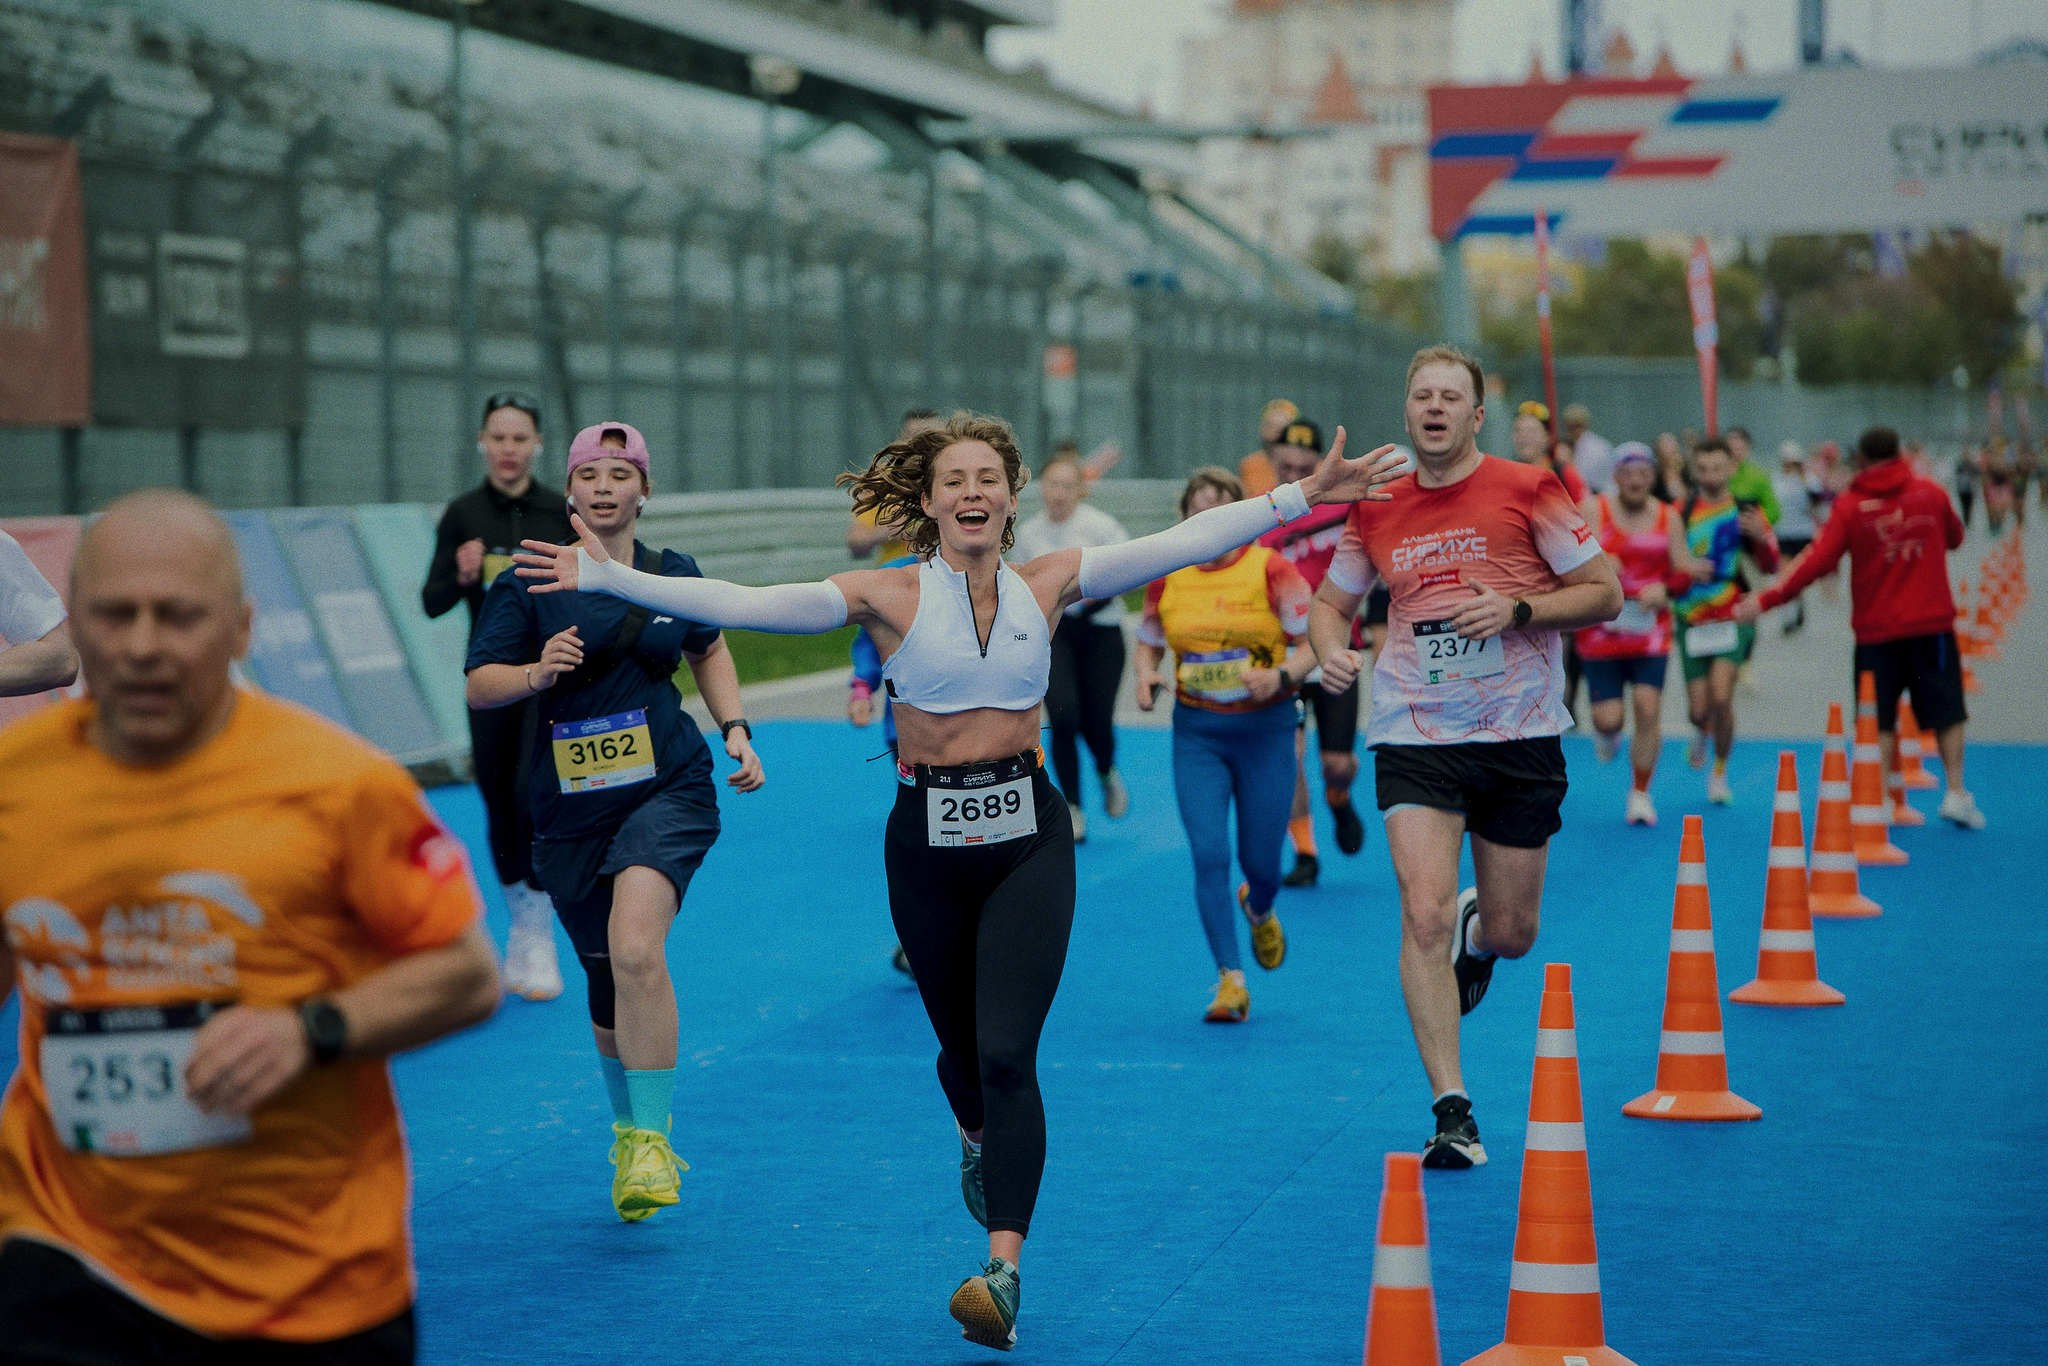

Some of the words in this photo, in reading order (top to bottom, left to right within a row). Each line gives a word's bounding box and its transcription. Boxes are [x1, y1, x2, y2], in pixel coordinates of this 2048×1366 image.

[1391, 537, 1487, 563] СИРИУС
[1429, 635, 1486, 658] 2377
[569, 734, 637, 764] 3162
[941, 790, 1020, 821] 2689
[68, 1052, 174, 1102] 253
